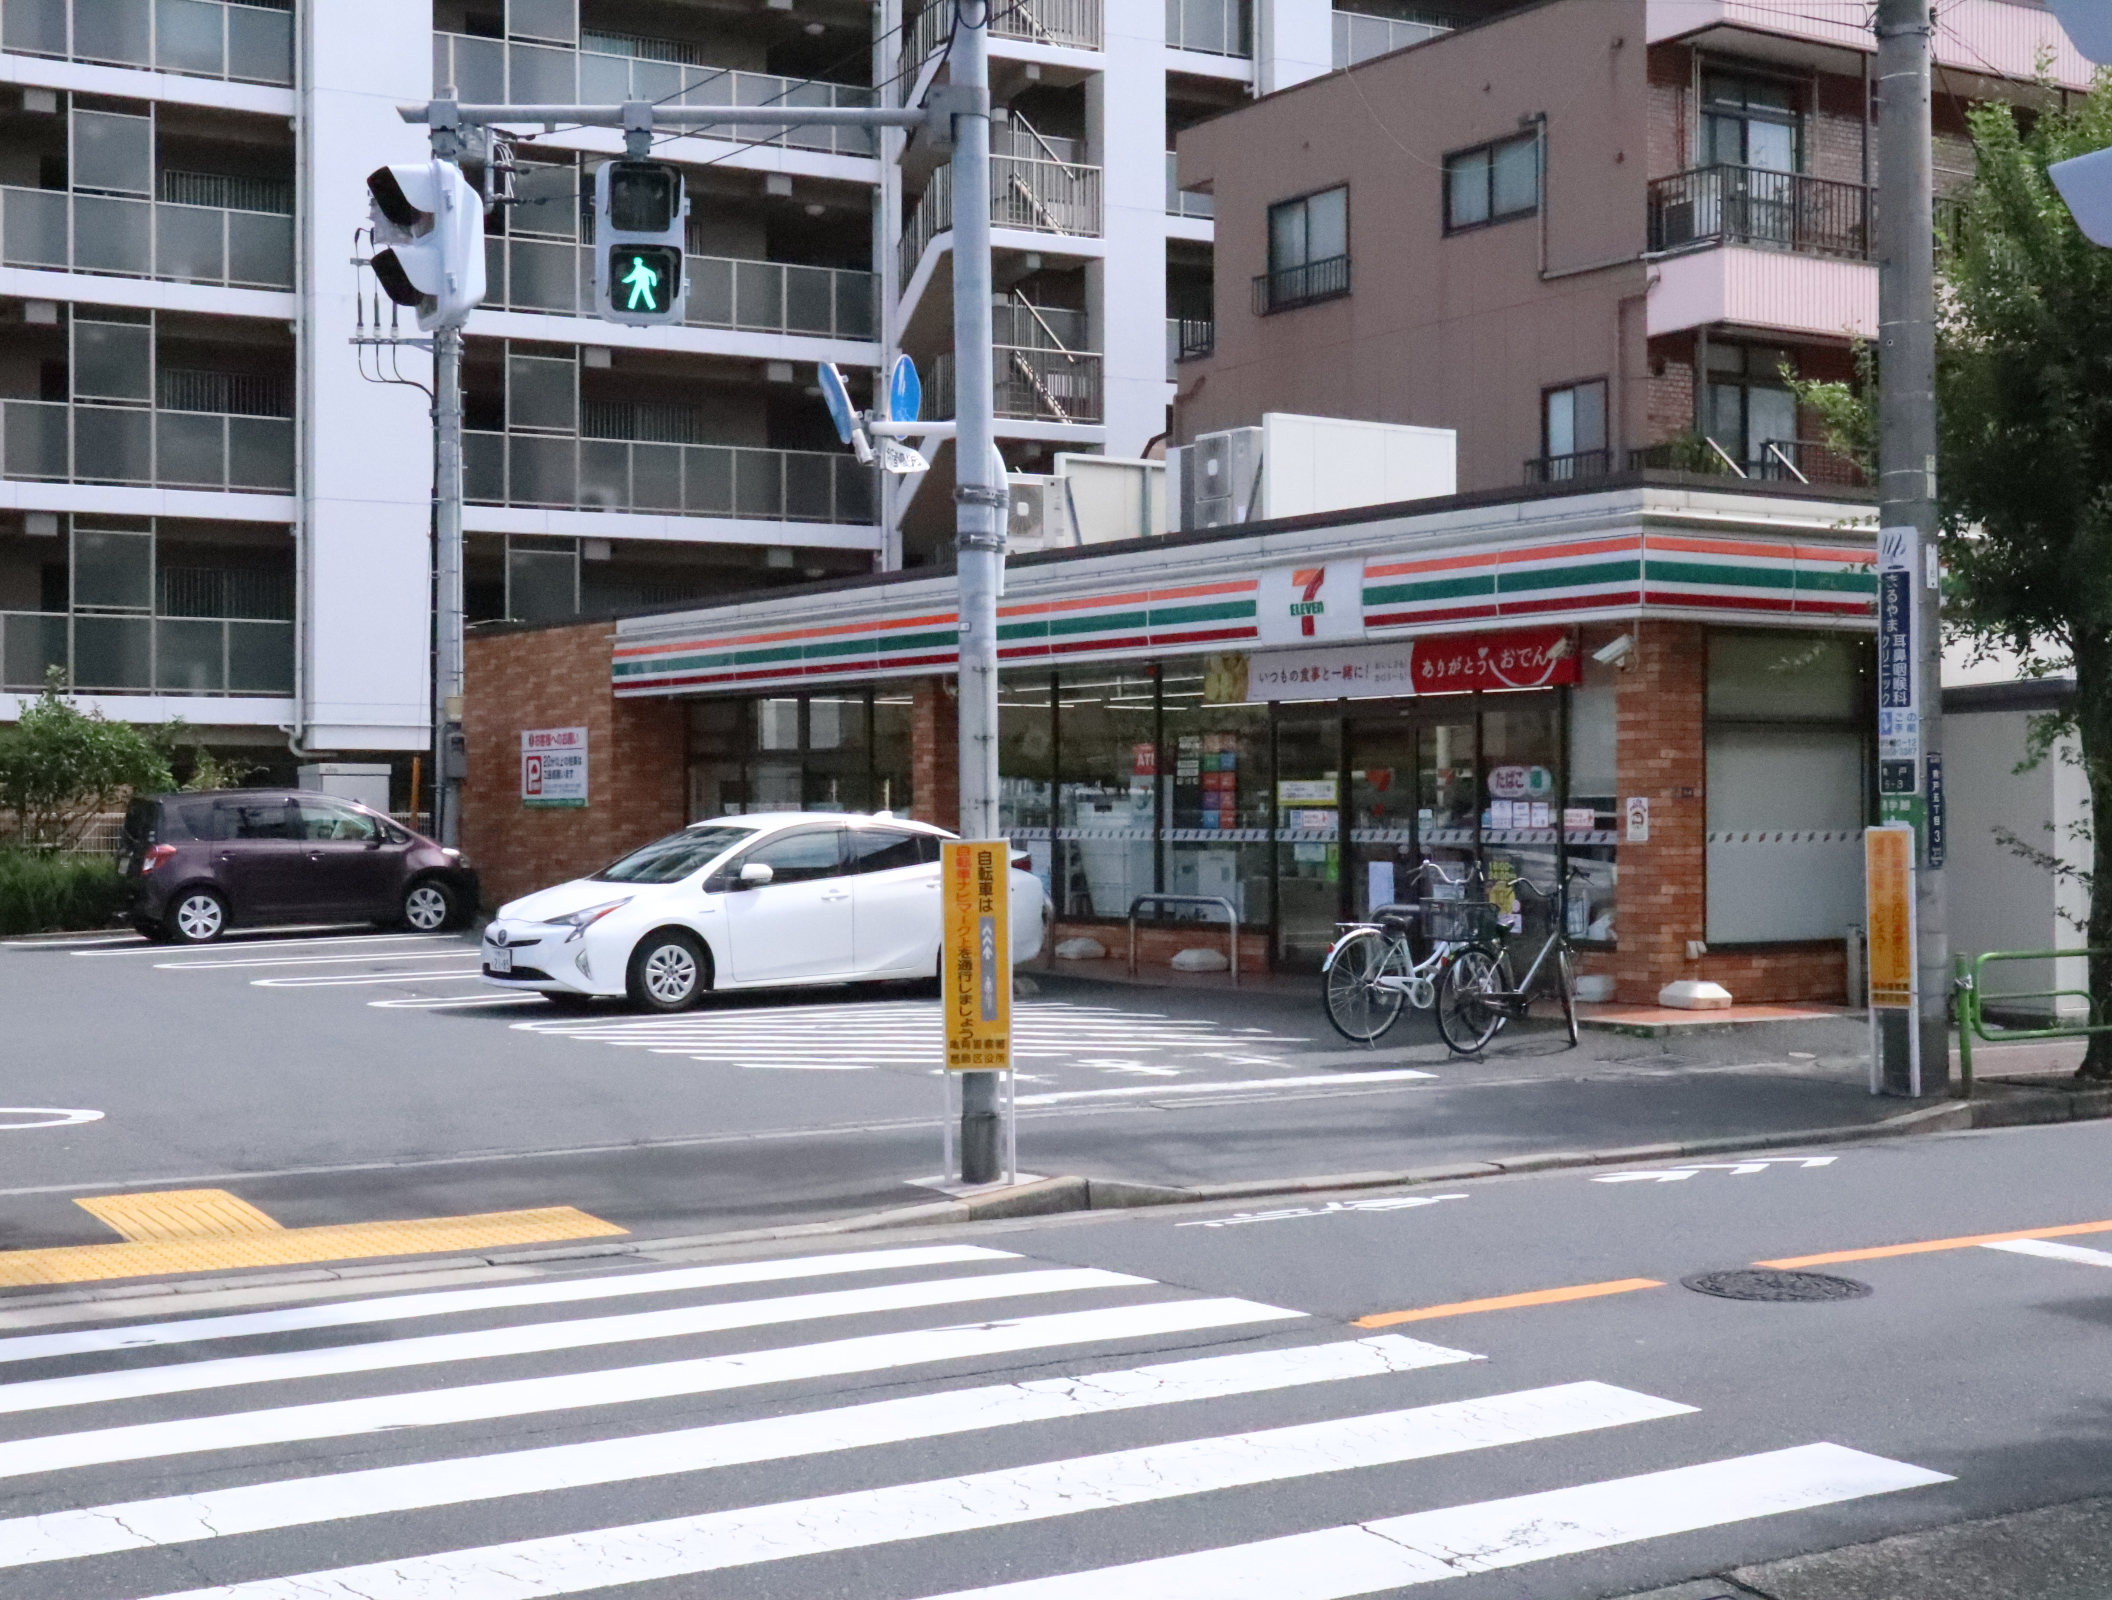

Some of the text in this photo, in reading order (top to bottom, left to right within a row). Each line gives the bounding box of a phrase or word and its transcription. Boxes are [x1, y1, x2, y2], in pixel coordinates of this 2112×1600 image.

[1292, 566, 1325, 636] 7
[1421, 646, 1549, 678] ありがとう おでん
[1495, 770, 1524, 789] たばこ
[977, 850, 994, 913] 自転車は
